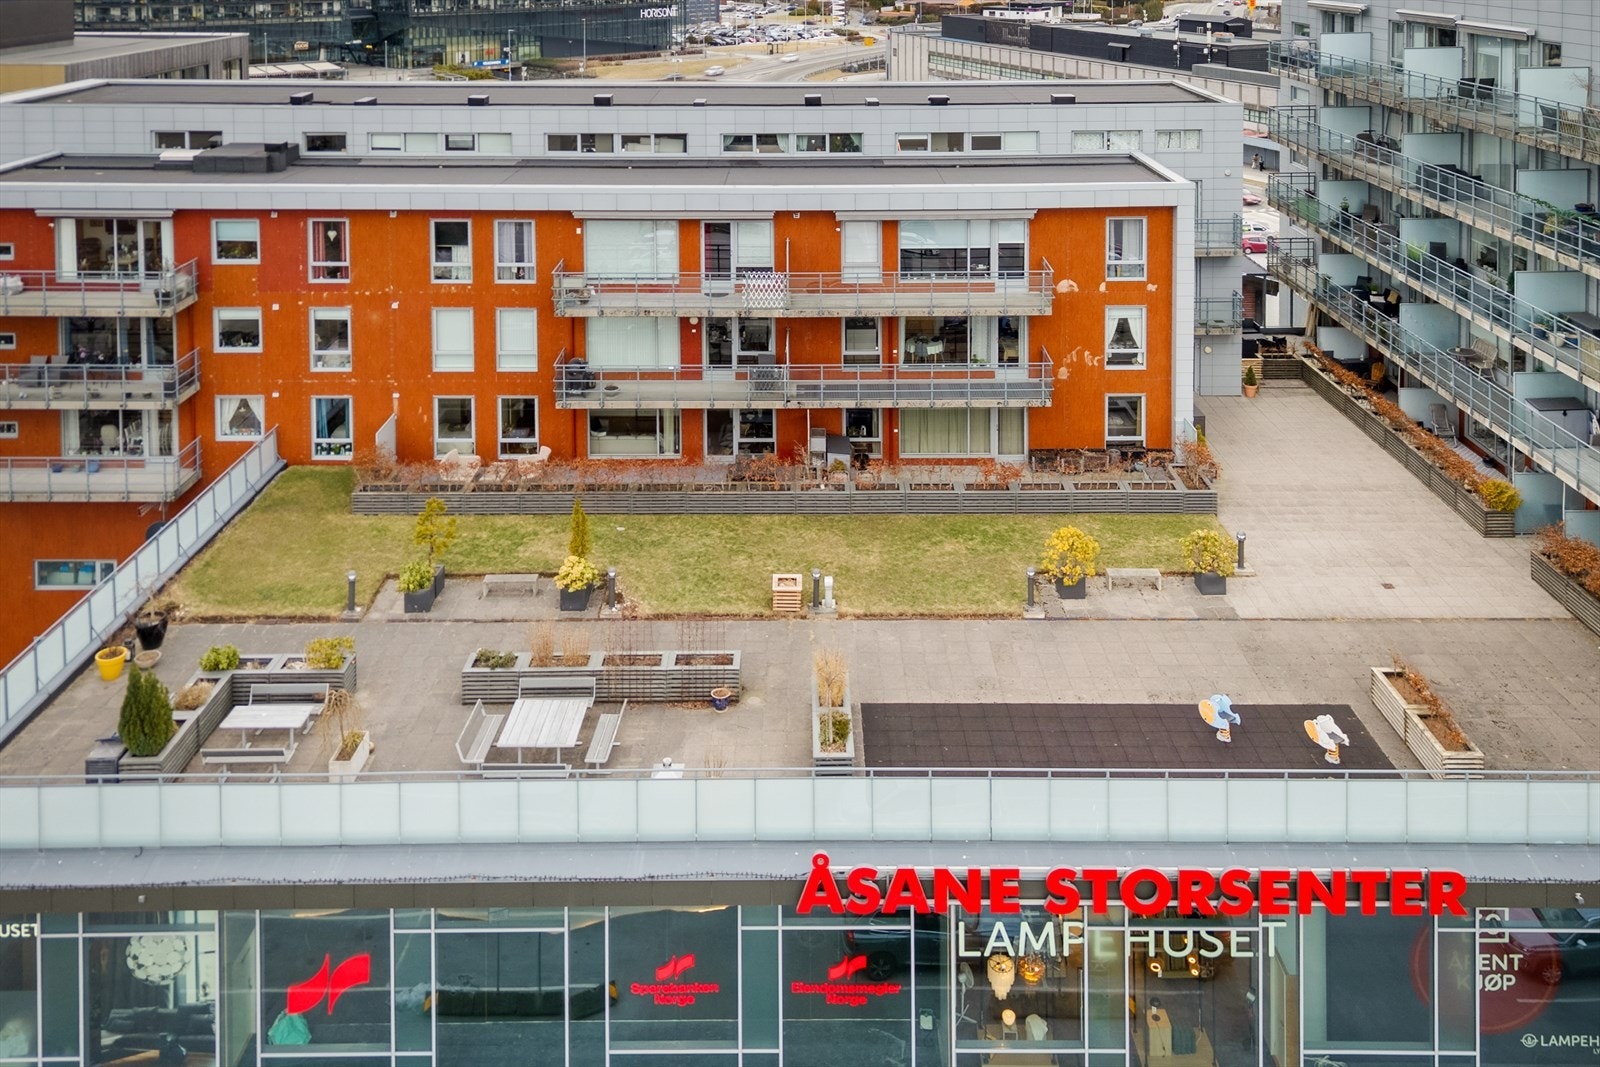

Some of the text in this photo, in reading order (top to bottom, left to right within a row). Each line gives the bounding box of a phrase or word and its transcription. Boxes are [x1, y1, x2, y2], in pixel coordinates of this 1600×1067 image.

[640, 7, 679, 18] HORISONT
[796, 850, 1467, 916] ÅSANE STORSENTER
[957, 921, 1287, 958] LAMPEHUSET
[630, 982, 719, 995] Sparebanken
[654, 993, 695, 1007] Norge
[826, 993, 867, 1006] Norge
